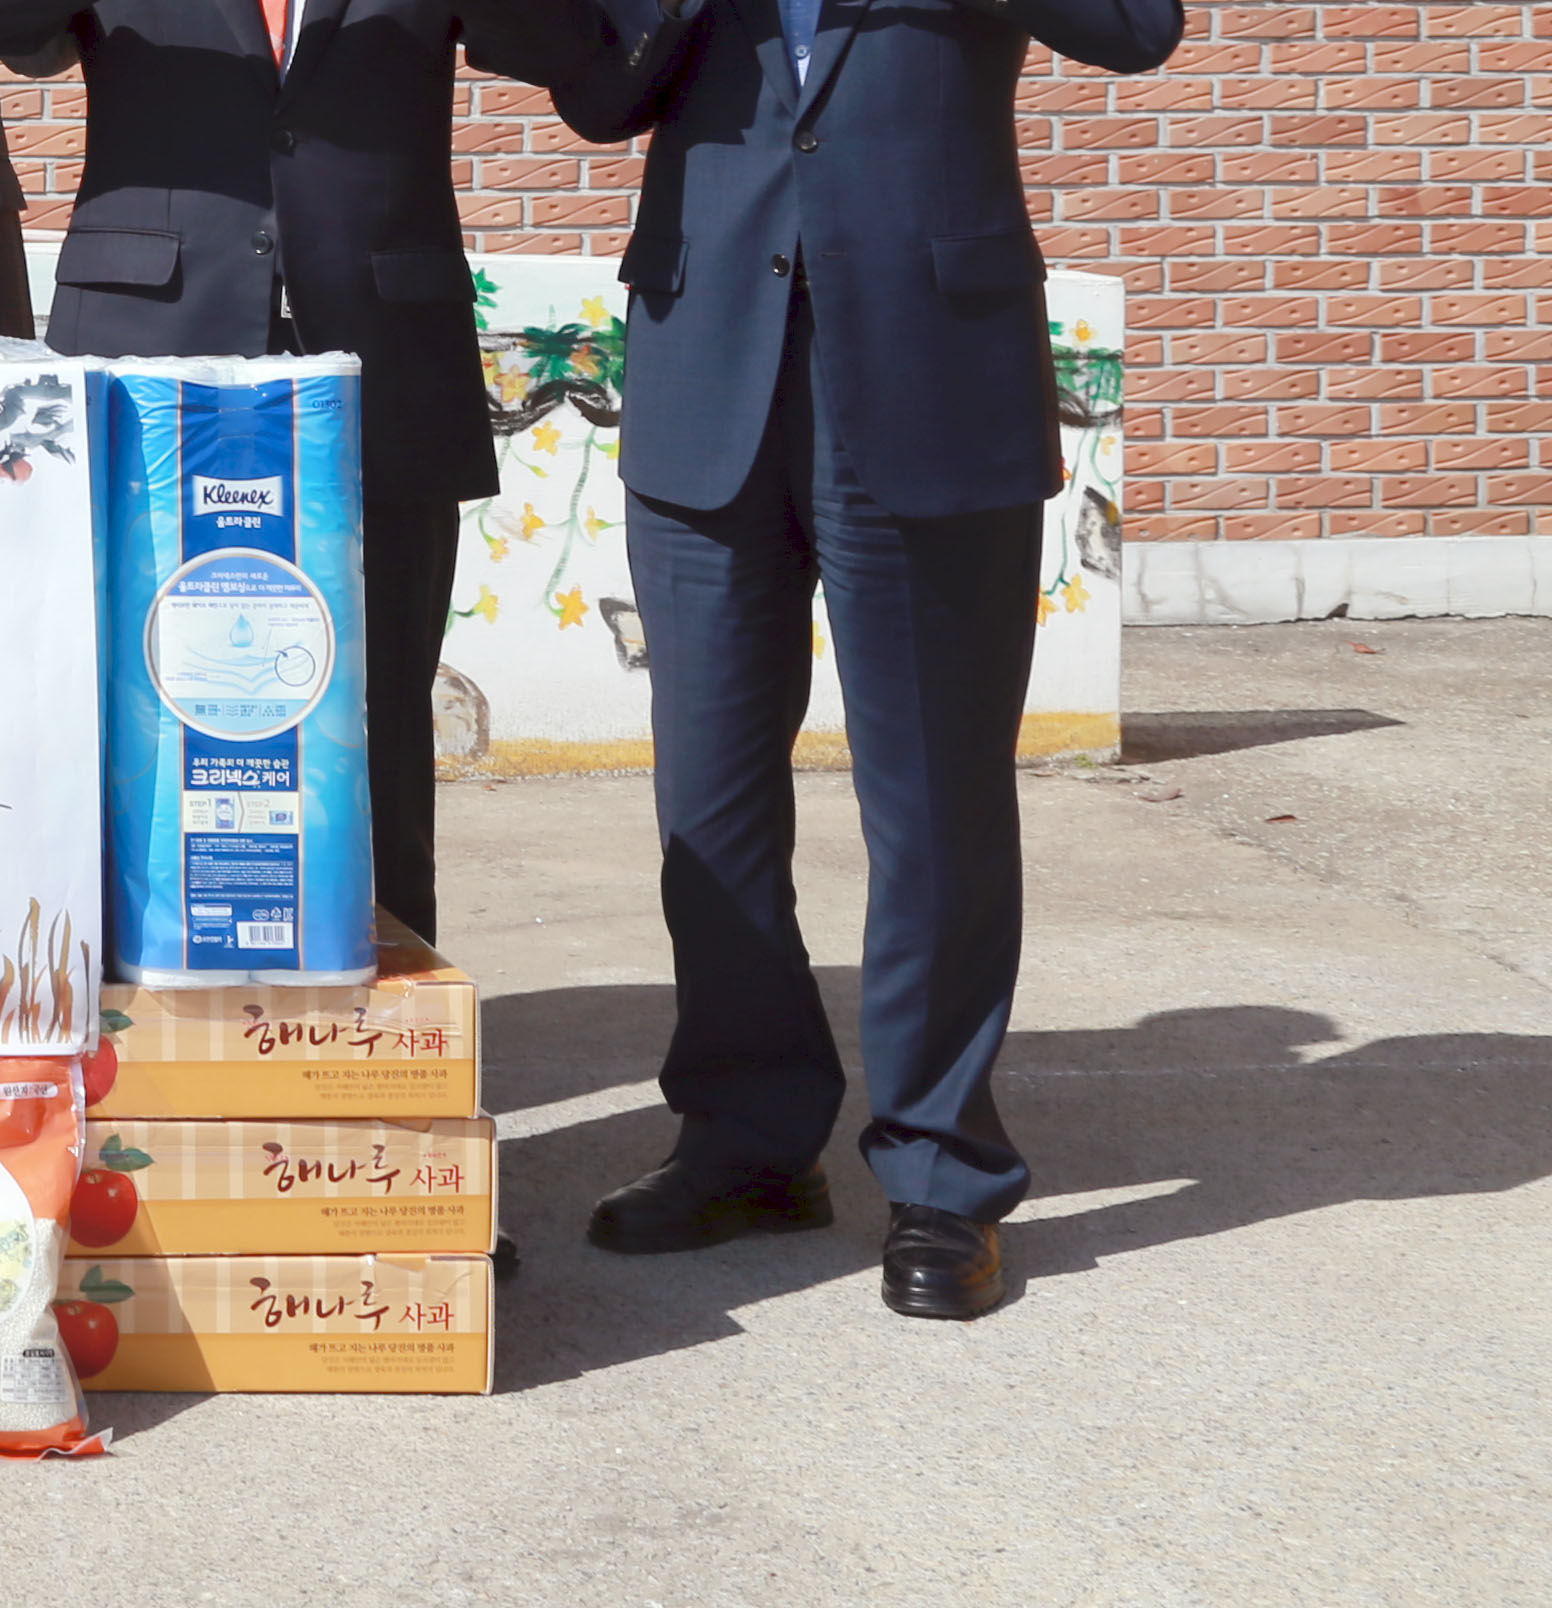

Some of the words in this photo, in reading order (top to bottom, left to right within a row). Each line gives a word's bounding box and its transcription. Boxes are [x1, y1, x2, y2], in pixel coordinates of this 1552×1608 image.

[203, 483, 274, 509] Kleenex
[190, 768, 261, 787] 크리넥스
[262, 770, 290, 787] 케어
[242, 1004, 383, 1058] 해나루
[392, 1028, 449, 1058] 사과
[262, 1142, 401, 1194] 해나루
[409, 1164, 465, 1194] 사과
[249, 1277, 390, 1331] 해나루
[399, 1302, 454, 1331] 사과
